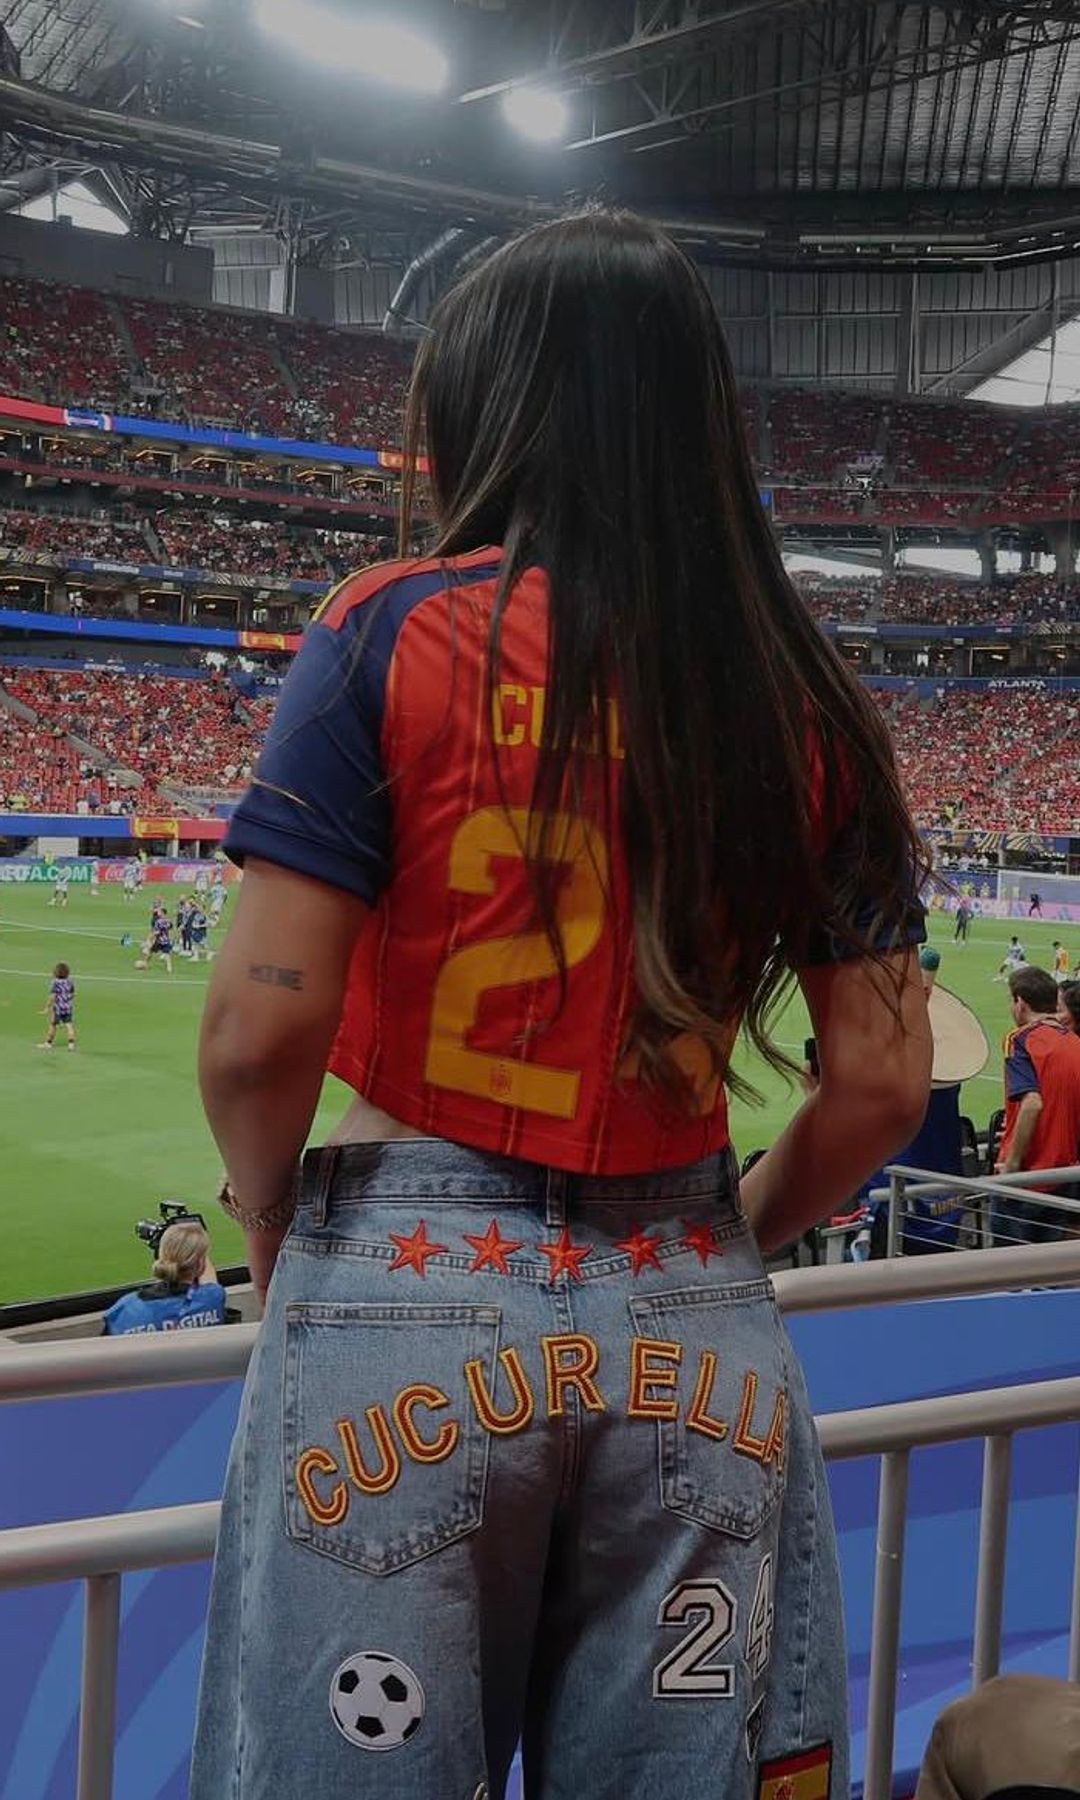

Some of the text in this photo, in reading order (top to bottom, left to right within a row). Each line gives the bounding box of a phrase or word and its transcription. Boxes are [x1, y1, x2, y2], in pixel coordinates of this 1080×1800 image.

[988, 680, 1047, 690] ATLANTA
[295, 1332, 788, 1526] CUCURELLA
[652, 1552, 774, 1699] 24
